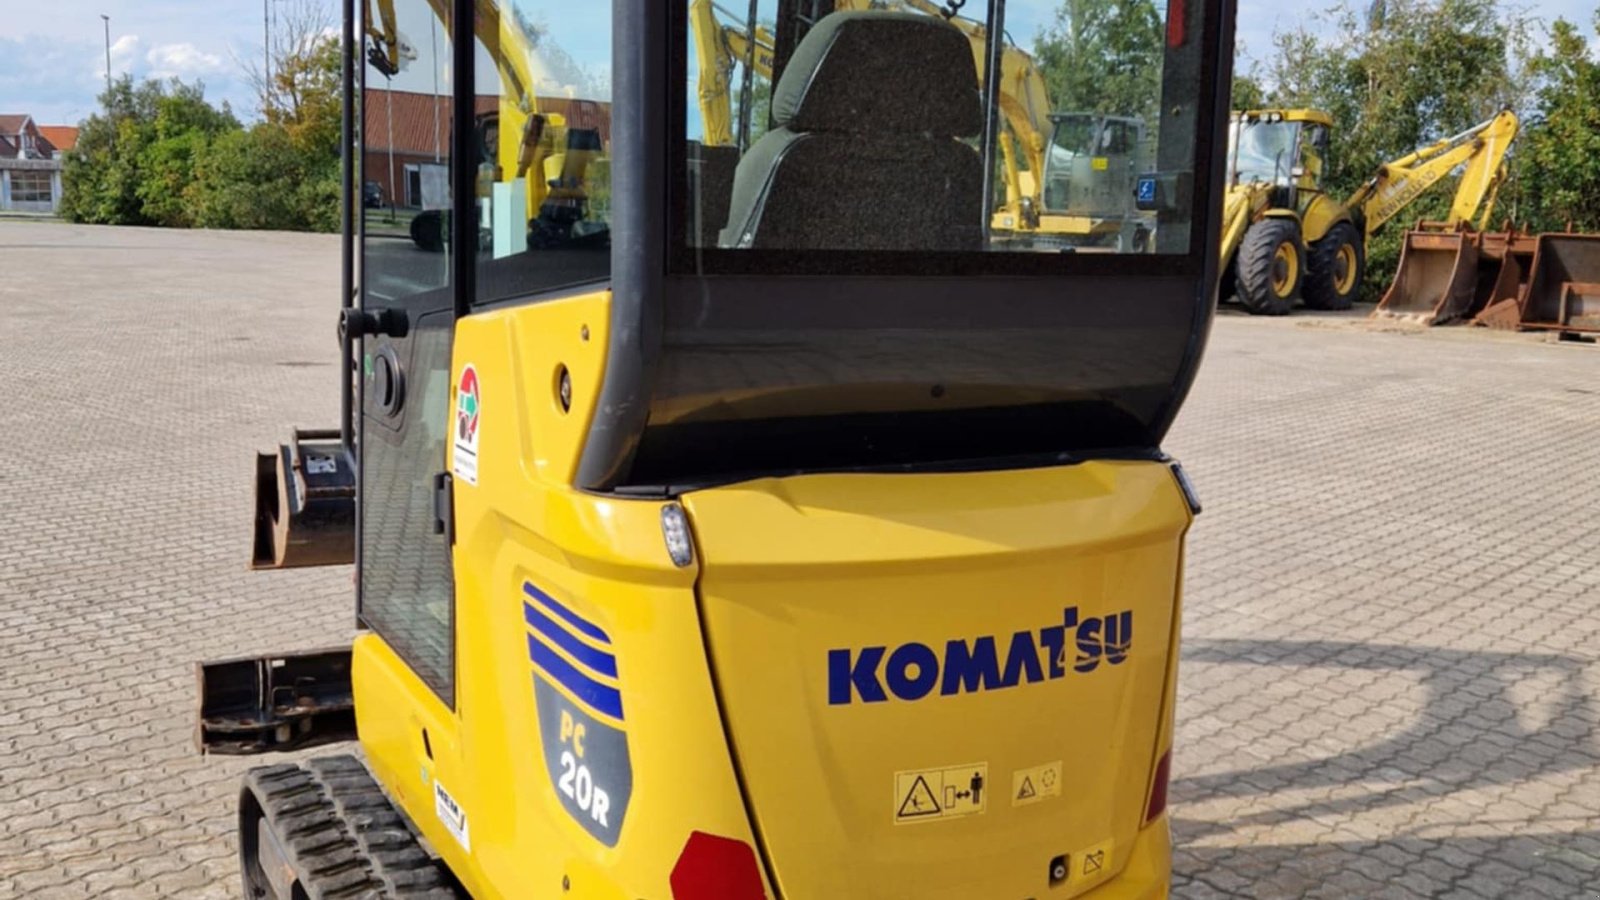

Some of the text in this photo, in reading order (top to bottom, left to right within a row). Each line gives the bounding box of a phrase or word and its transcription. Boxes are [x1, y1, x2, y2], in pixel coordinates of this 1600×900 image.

[828, 606, 1132, 705] KOMATSU
[560, 709, 586, 758] PC
[558, 751, 611, 828] 20R
